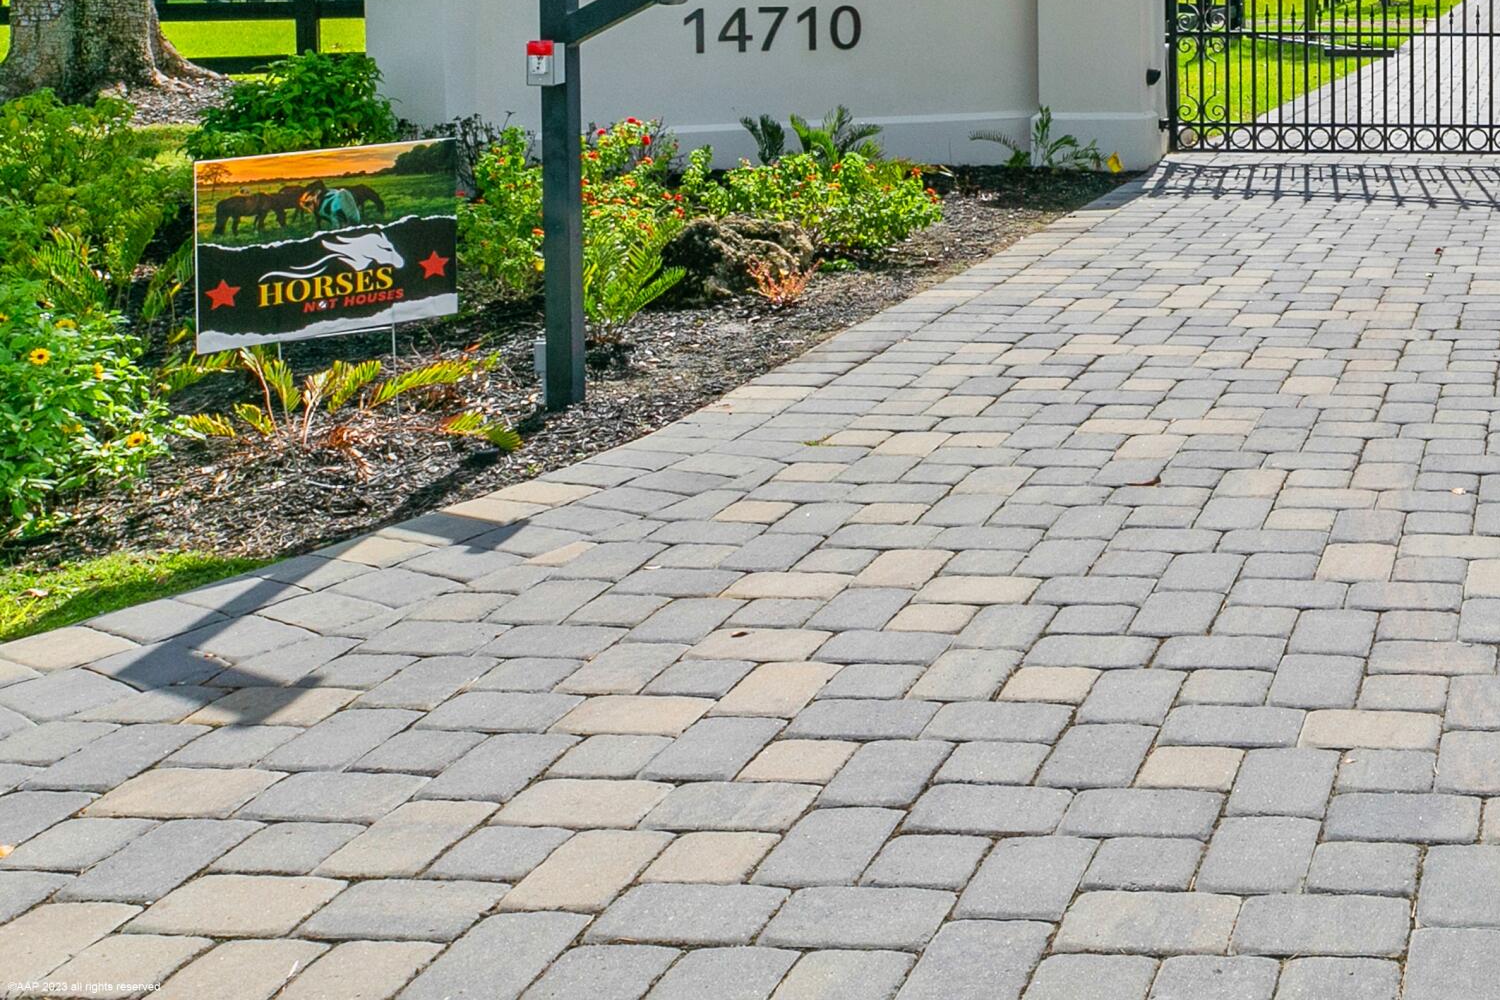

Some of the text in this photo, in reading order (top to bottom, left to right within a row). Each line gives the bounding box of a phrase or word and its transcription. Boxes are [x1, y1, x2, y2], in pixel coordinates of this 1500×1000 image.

[683, 5, 862, 53] 14710
[258, 266, 393, 307] HORSES
[303, 288, 404, 313] NOT HOUSES
